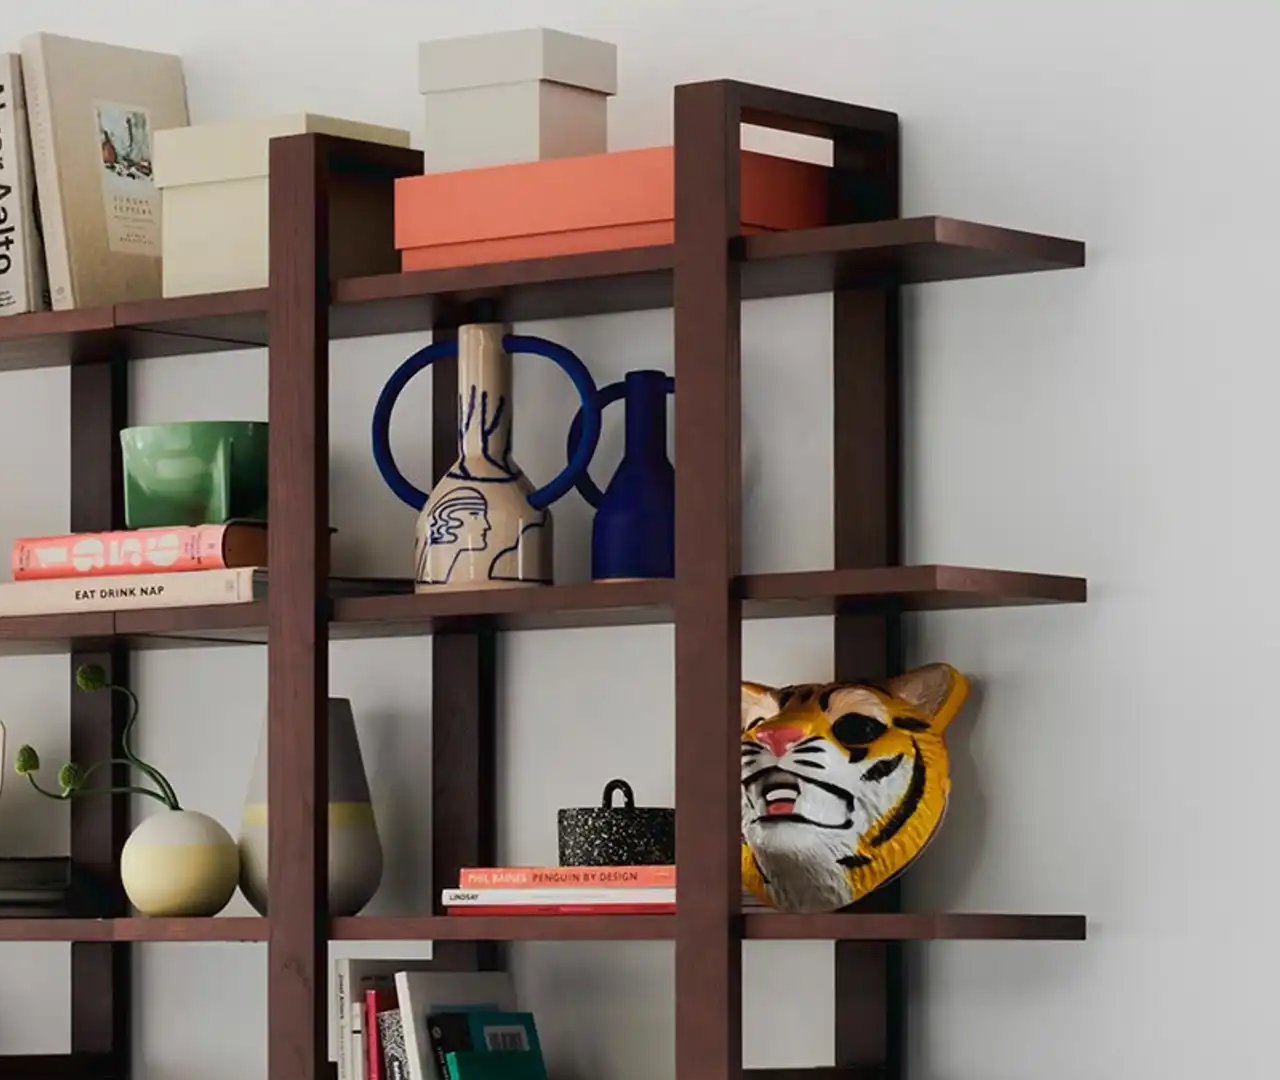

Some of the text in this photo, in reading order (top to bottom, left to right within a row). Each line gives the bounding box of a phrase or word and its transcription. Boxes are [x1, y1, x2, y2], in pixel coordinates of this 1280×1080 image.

[74, 585, 165, 600] EAT DRINK NAP
[532, 873, 580, 883] PENGUIN
[583, 873, 597, 882] BY
[599, 872, 639, 882] DESIGN
